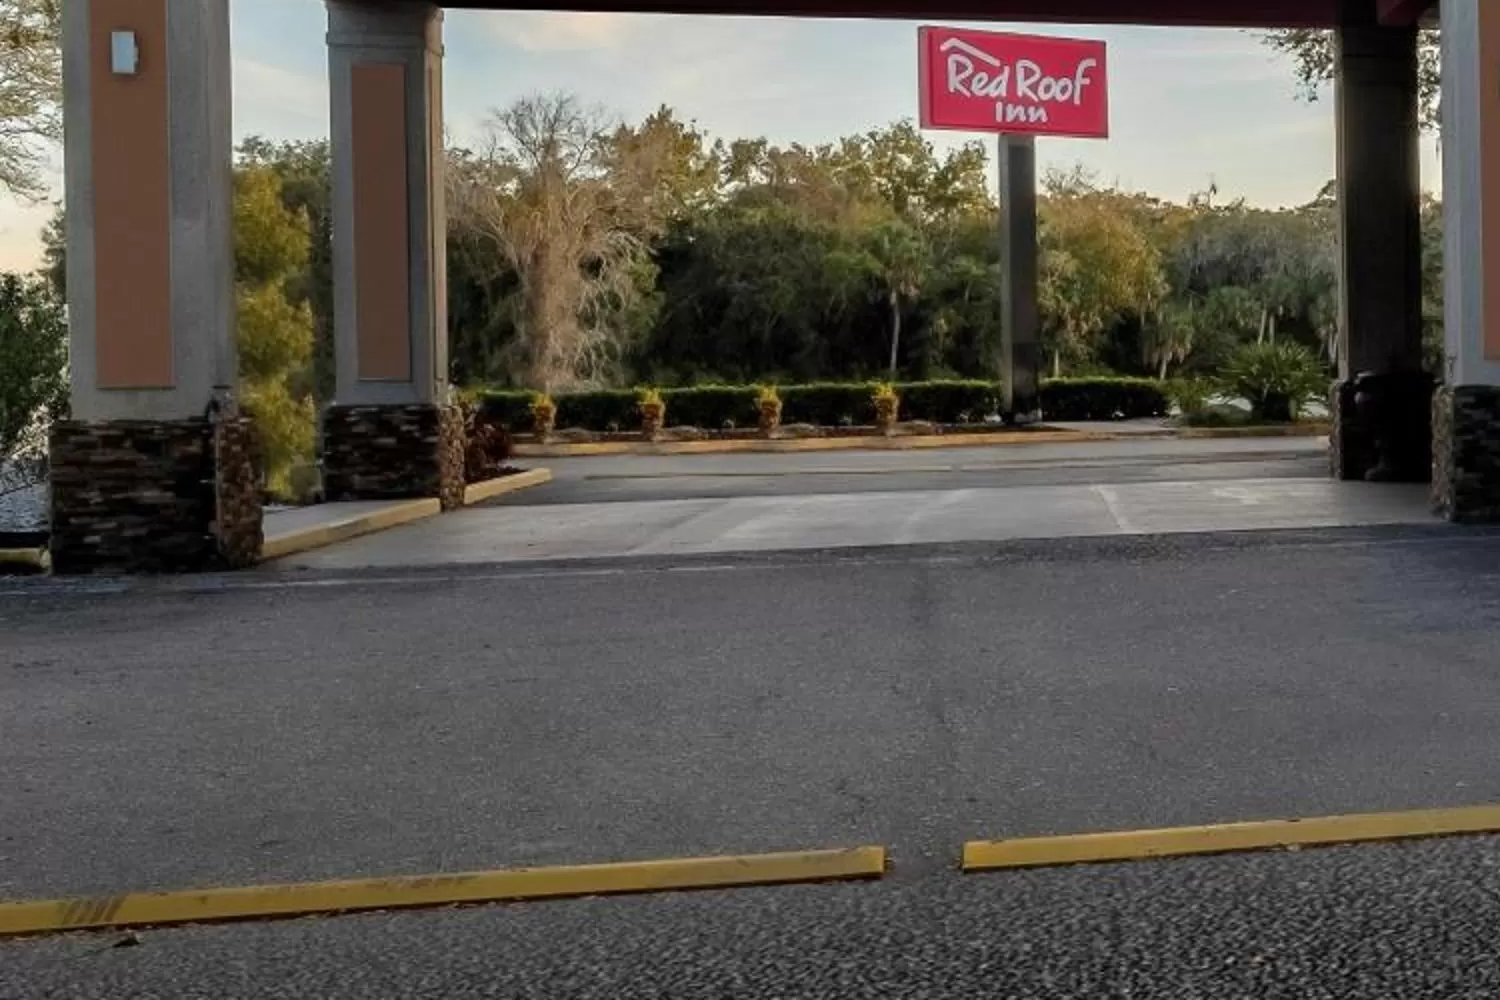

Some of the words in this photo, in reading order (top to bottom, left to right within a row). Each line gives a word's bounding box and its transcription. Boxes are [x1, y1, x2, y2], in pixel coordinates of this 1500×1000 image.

[947, 53, 1010, 98] Red
[1015, 58, 1097, 105] Roof
[995, 101, 1048, 123] Inn
